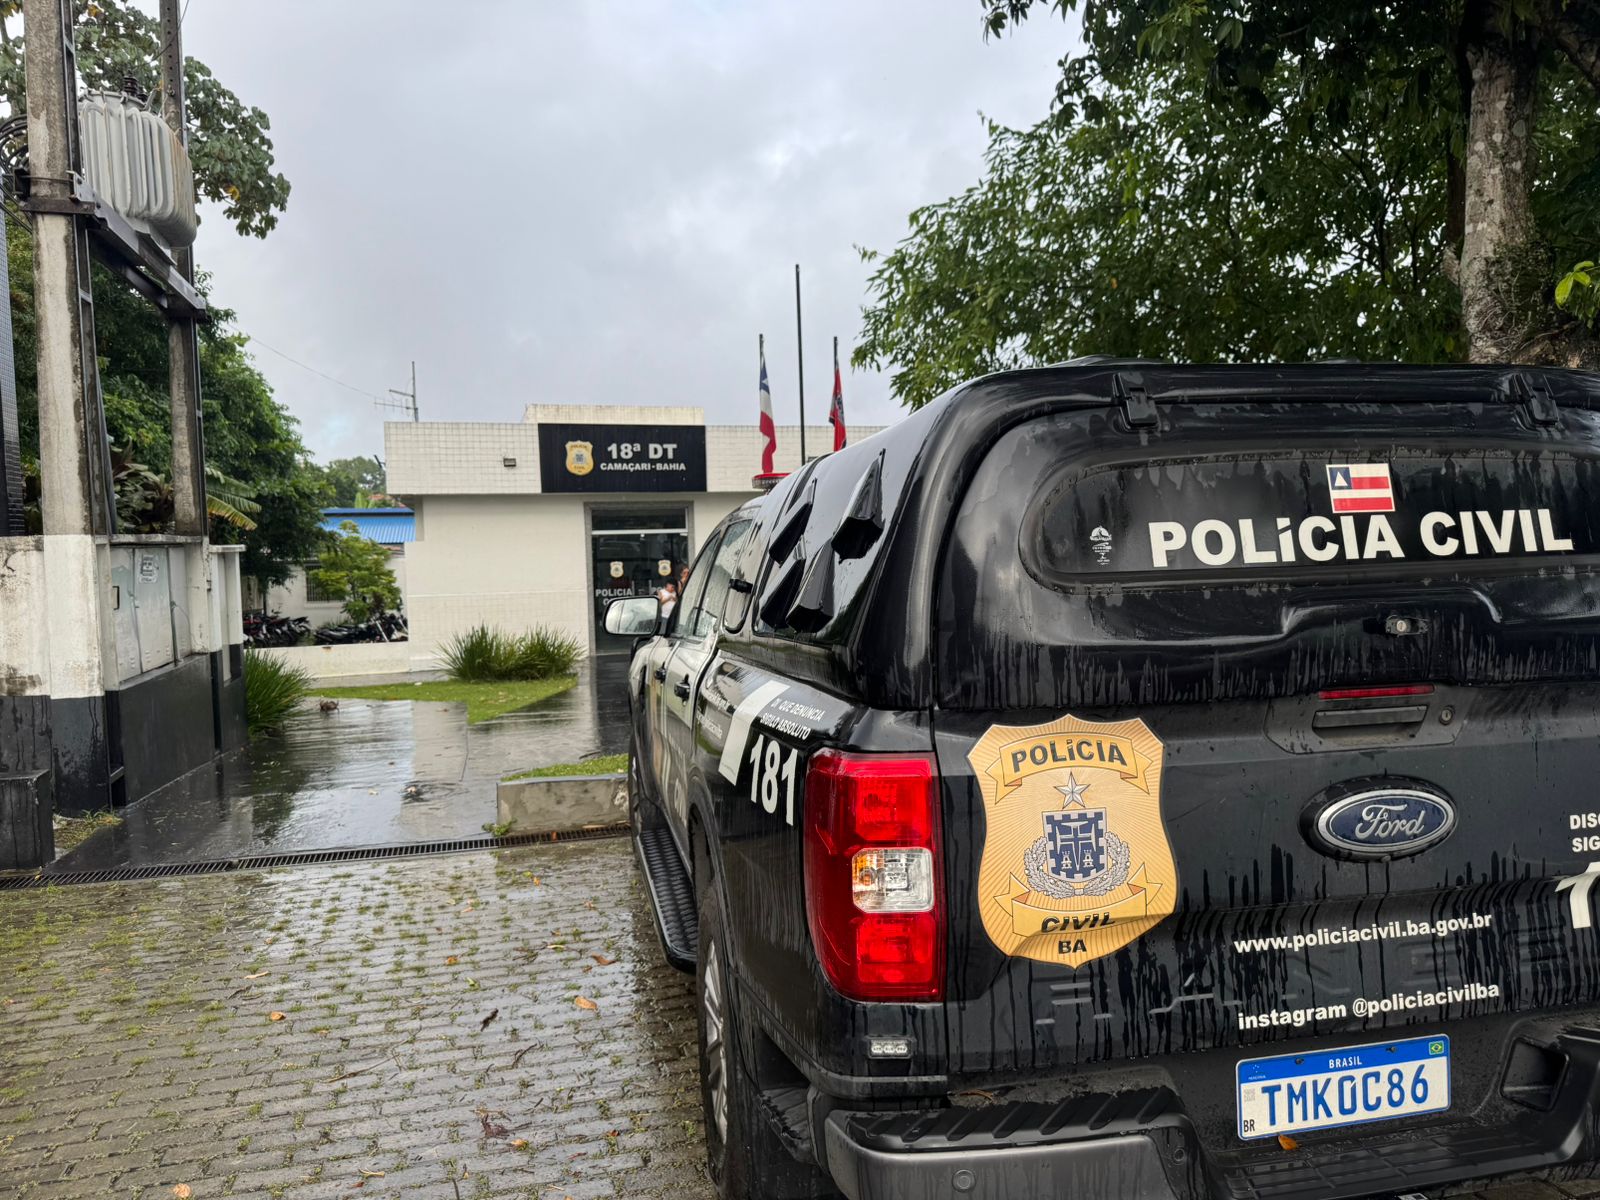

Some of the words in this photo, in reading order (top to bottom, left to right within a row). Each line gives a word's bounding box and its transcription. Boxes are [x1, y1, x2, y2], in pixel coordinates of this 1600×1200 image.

[648, 443, 678, 460] DT
[1419, 508, 1574, 556] CIVIL
[776, 718, 812, 741] ABSOLUTO
[750, 734, 798, 826] 181
[1355, 803, 1426, 840] Ford
[1569, 812, 1600, 830] DIS
[1041, 911, 1117, 934] CIVIL
[1233, 912, 1493, 953] www.policiacivil.ba.gov.br
[1057, 939, 1087, 955] BA
[1238, 1004, 1347, 1030] instagram
[1352, 982, 1500, 1018] @policiacivilba
[1328, 1055, 1363, 1069] BRASIL
[1243, 1119, 1255, 1132] BR
